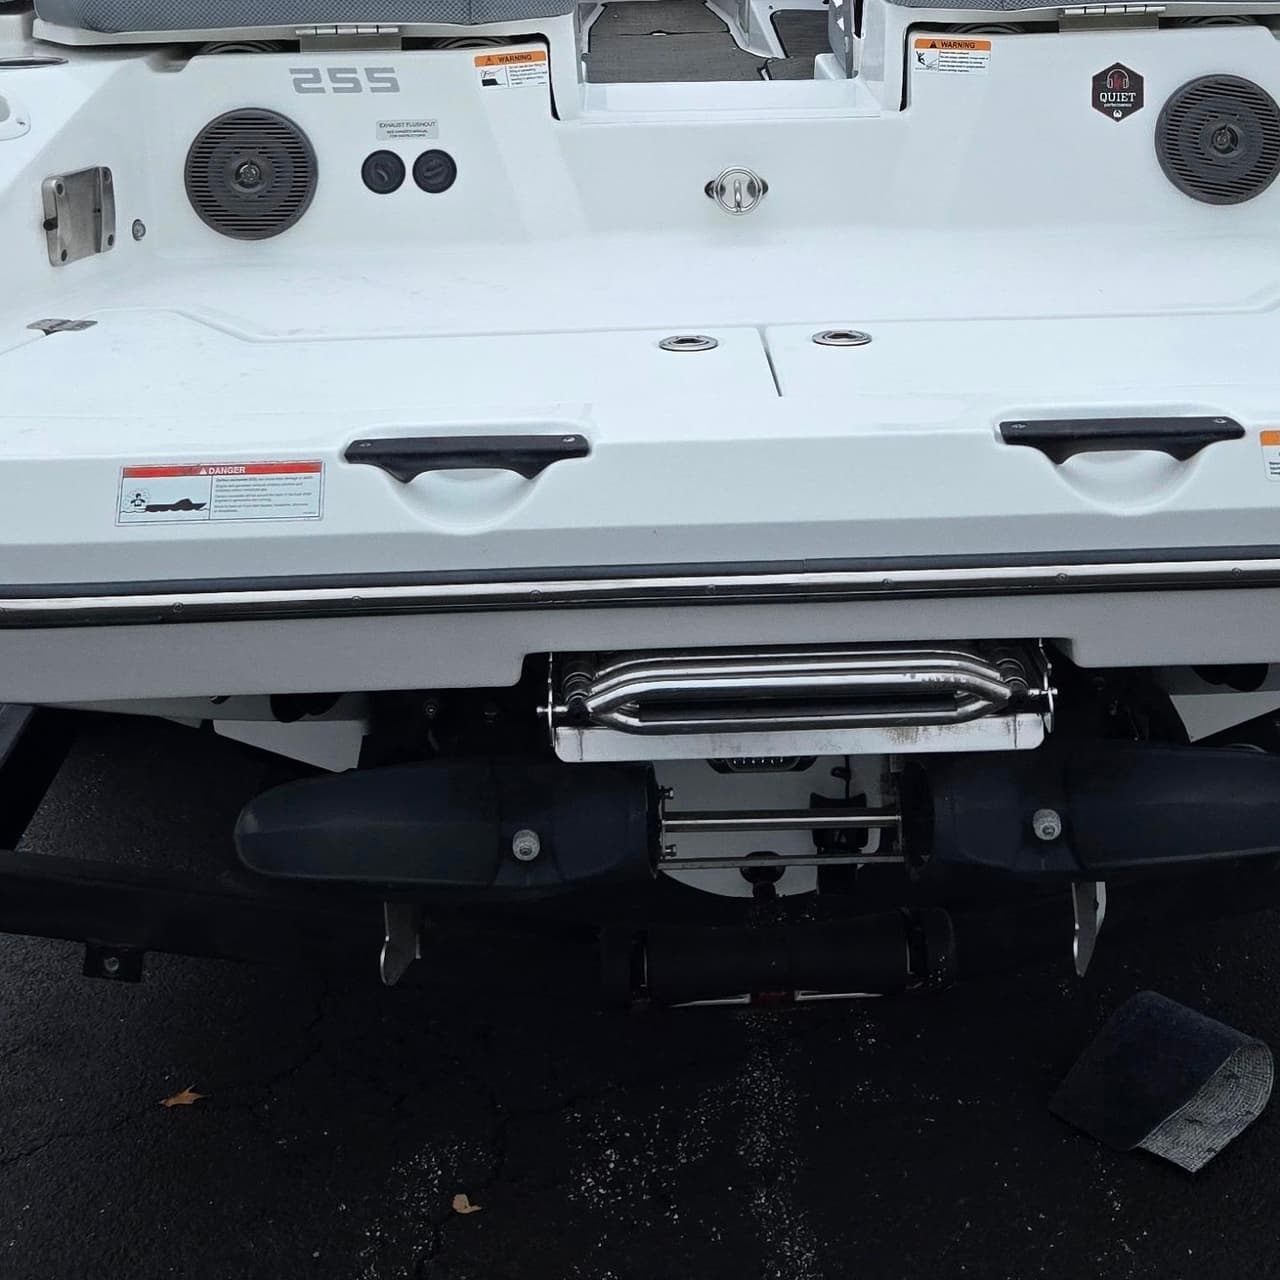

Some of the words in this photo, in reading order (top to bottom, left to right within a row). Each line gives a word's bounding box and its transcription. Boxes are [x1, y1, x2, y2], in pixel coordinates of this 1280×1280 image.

[940, 41, 976, 49] WARNING
[497, 54, 533, 64] WARNING
[289, 67, 401, 94] 255
[1099, 92, 1137, 103] QUIET
[208, 466, 246, 476] DANGER
